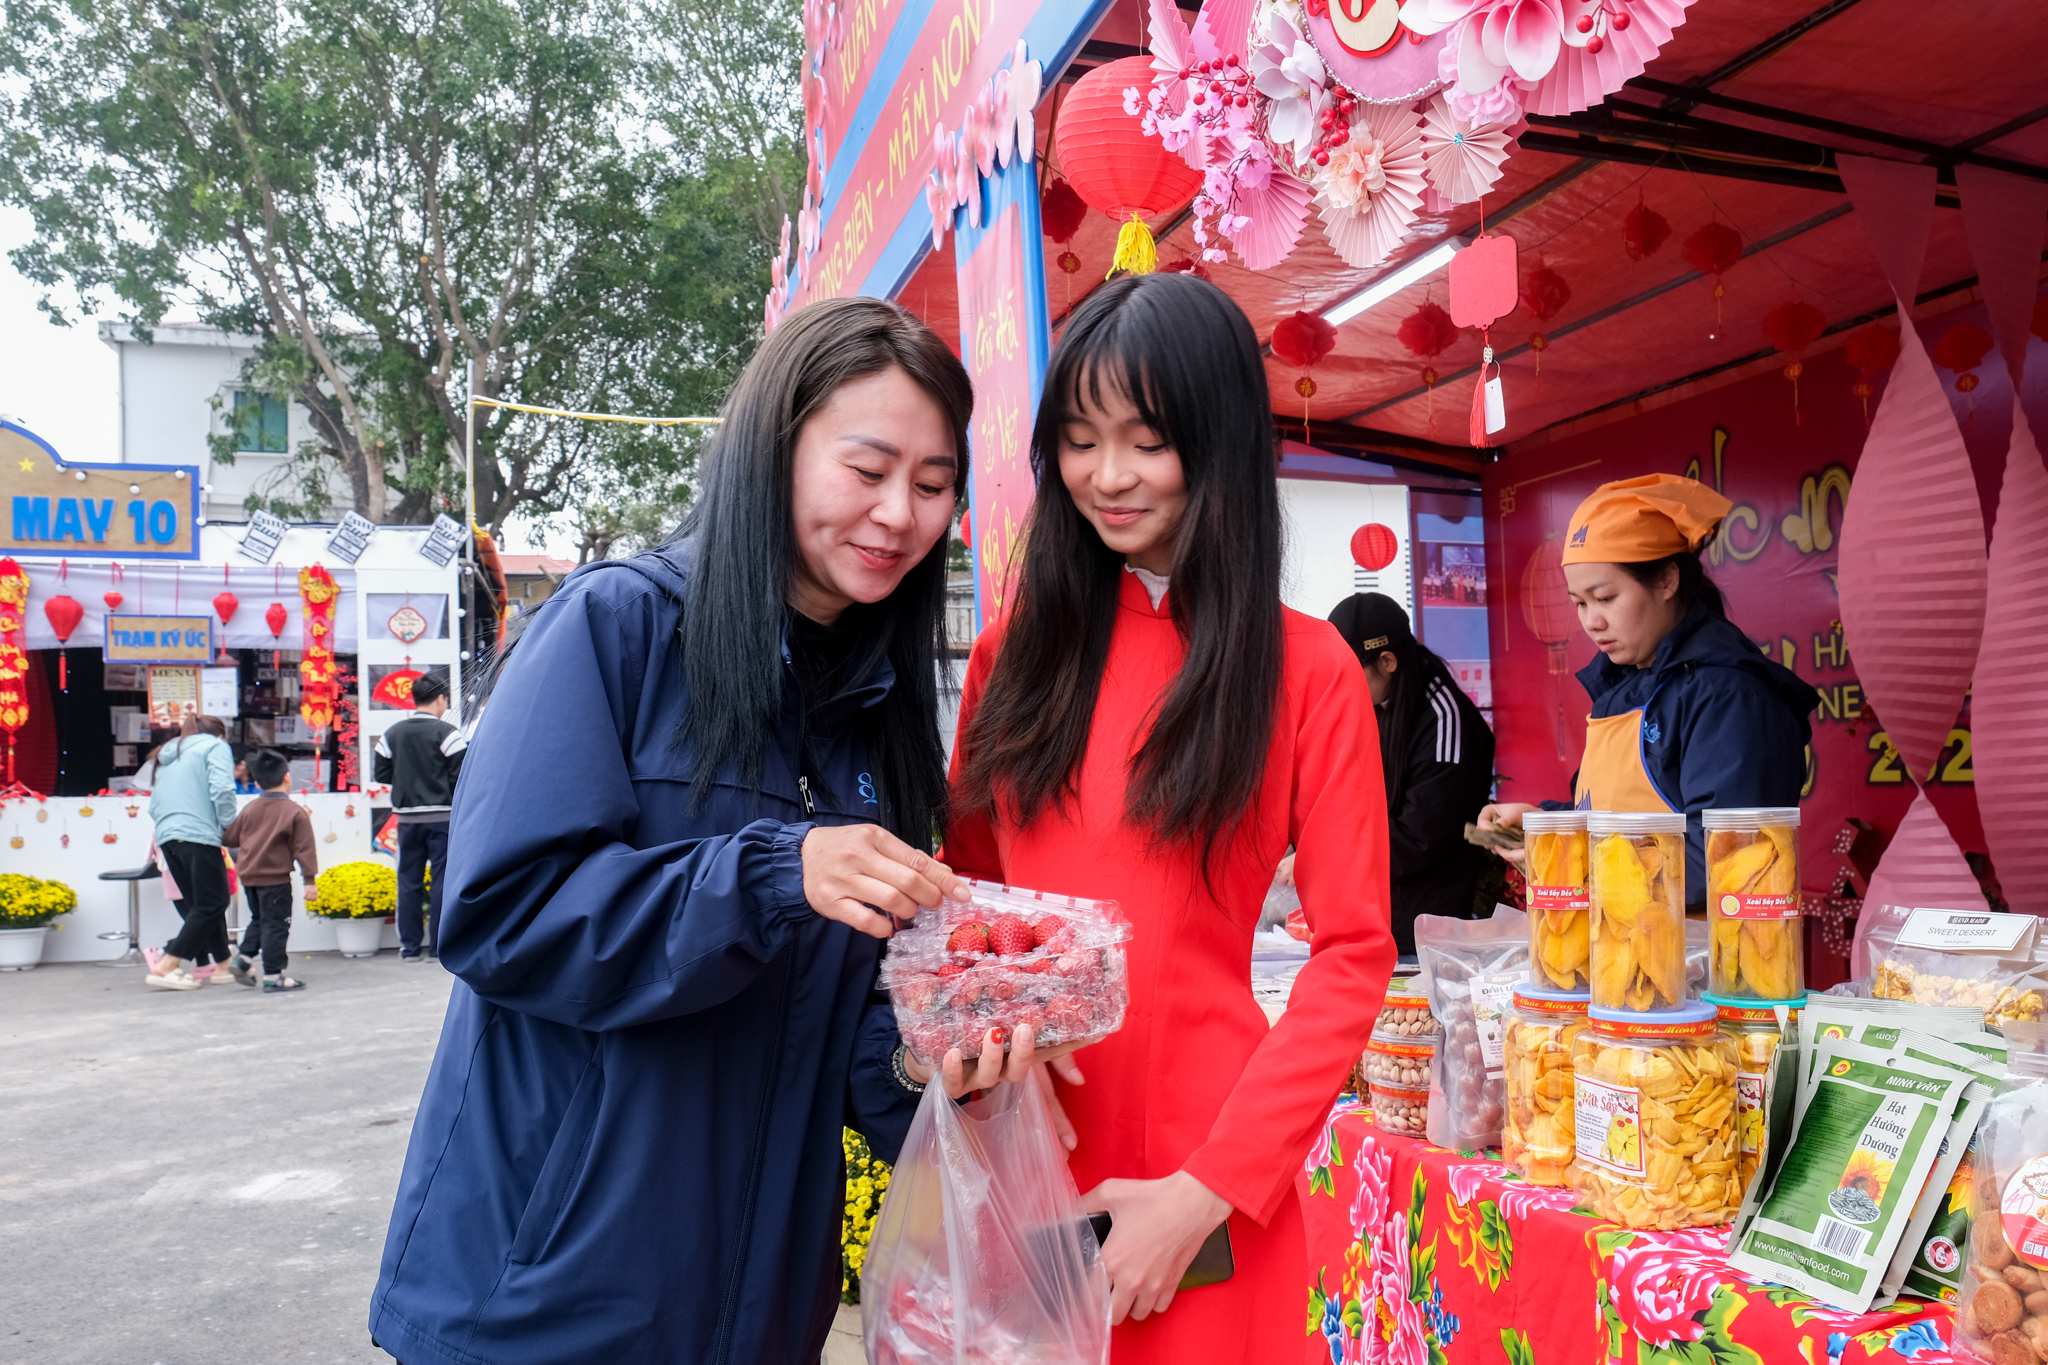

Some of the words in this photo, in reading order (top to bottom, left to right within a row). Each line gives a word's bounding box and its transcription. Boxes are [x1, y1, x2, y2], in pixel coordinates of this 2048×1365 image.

[843, 179, 873, 275] BIÊN
[932, 0, 981, 119] NON
[12, 495, 115, 542] MAY
[127, 499, 178, 544] 10
[112, 630, 156, 649] TRẠM
[152, 668, 197, 678] MENU
[1928, 926, 1958, 936] SWEET
[1958, 928, 1997, 937] DESSERT
[1885, 1075, 1915, 1089] MINH
[1915, 1079, 1942, 1094] VĂN
[1886, 1100, 1907, 1117] Hạt
[1869, 1116, 1907, 1140] Hướng
[1860, 1133, 1899, 1160] Dương
